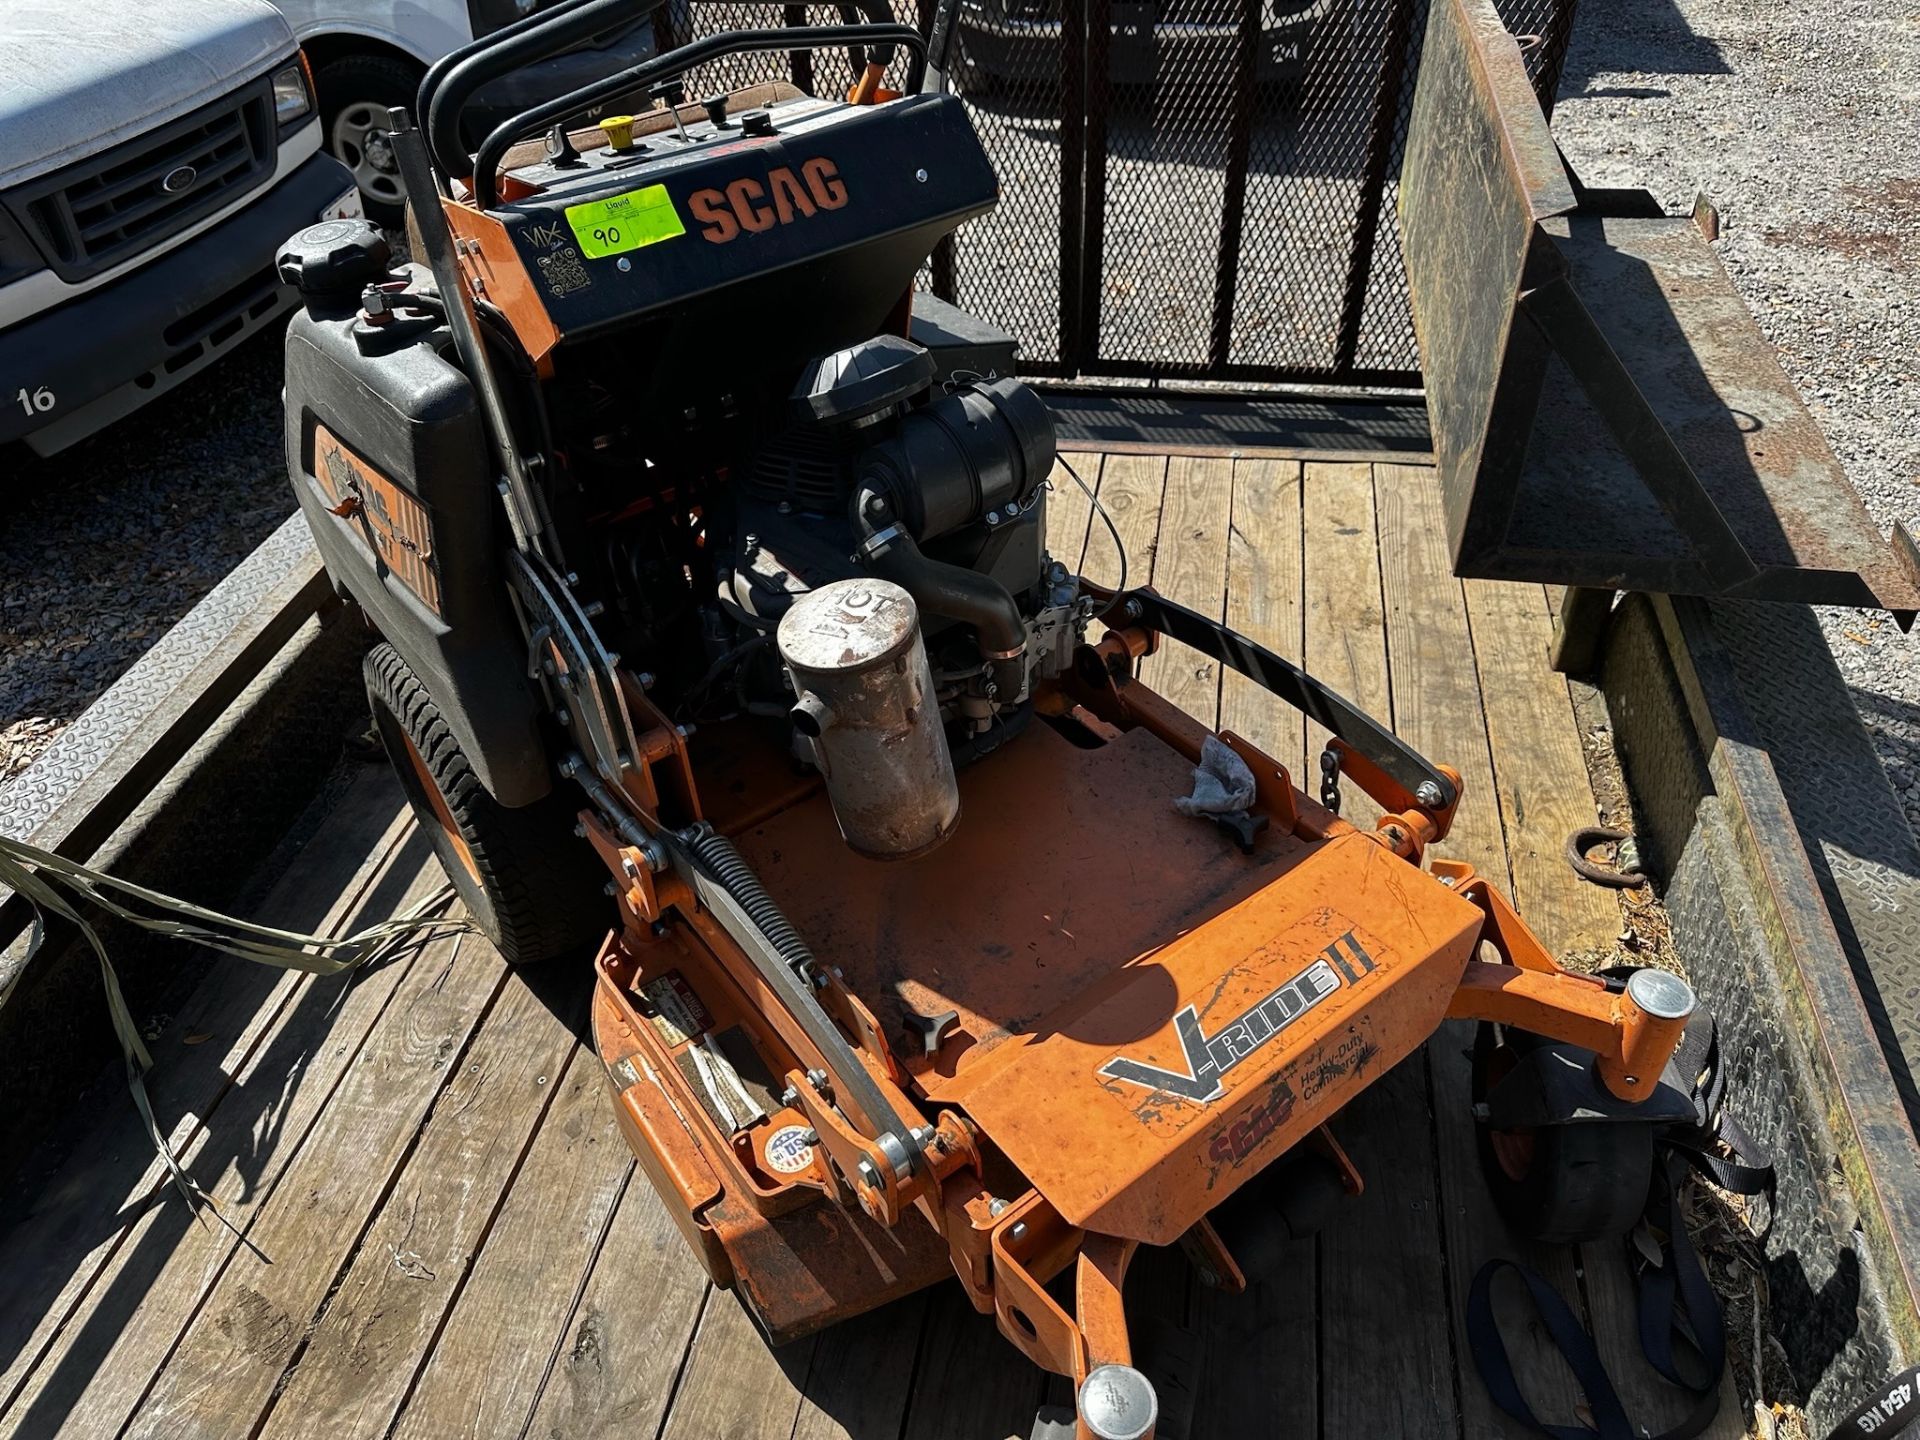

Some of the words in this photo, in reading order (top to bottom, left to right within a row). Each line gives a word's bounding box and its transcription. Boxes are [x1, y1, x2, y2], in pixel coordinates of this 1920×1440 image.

[605, 197, 630, 211] Liquid
[688, 157, 848, 244] SCAG
[593, 227, 620, 247] 90
[17, 386, 55, 416] 16
[819, 588, 896, 612] HOT
[1321, 931, 1377, 989] II
[1300, 1032, 1363, 1087] Heavy-Duty
[1880, 1384, 1910, 1416] 454
[1857, 1406, 1886, 1432] KG
